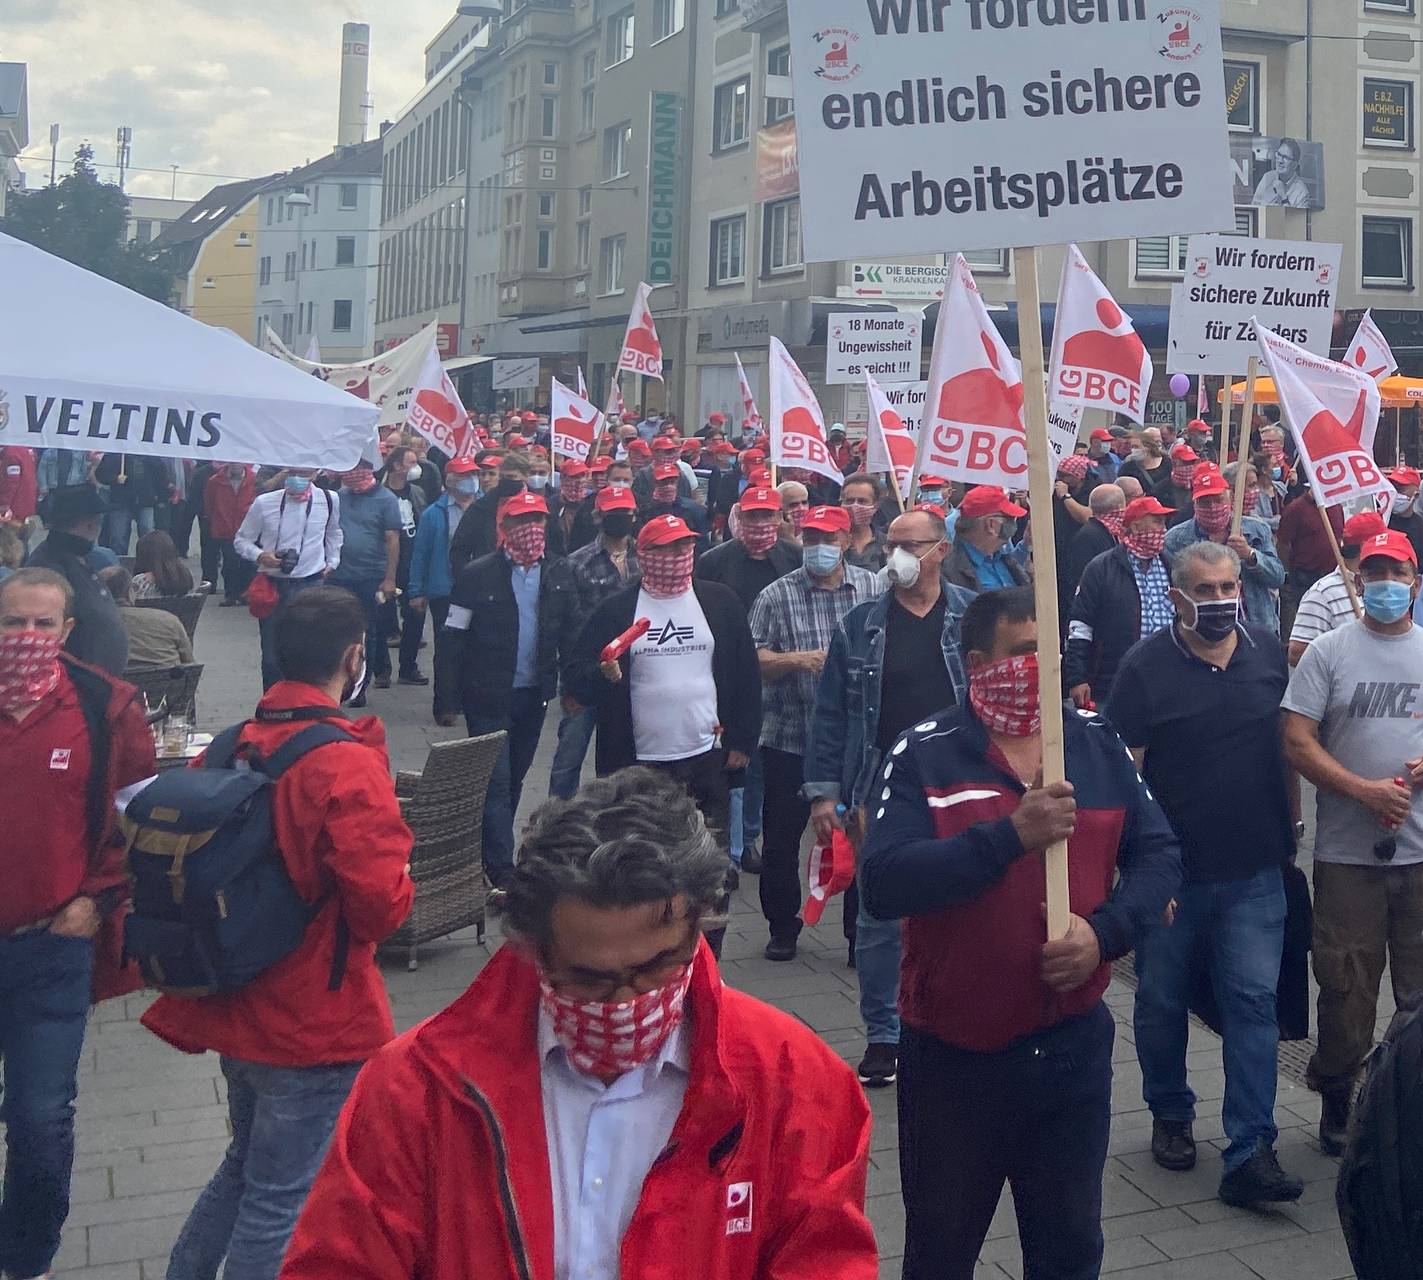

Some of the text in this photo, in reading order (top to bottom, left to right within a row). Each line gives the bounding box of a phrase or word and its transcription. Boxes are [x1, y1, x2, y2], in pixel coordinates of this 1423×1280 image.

[821, 68, 1201, 130] endlich sichere
[1226, 72, 1249, 113] NGLISCH
[1364, 104, 1405, 116] NACHHILFE
[650, 92, 678, 281] DEICHMANN
[854, 157, 1183, 220] Arbeitsplätze
[886, 266, 949, 276] DIE BERGISC
[1216, 247, 1315, 271] Wir fordern
[1190, 283, 1330, 308] sichere Zukunft
[848, 318, 904, 331] 18 Monate
[1205, 320, 1232, 341] für
[1236, 322, 1308, 345] Zaders
[838, 339, 912, 355] Ungewissheit
[848, 365, 861, 374] es
[864, 361, 896, 373] reicht
[1150, 400, 1172, 414] 100
[1150, 413, 1173, 424] TAGE
[24, 394, 222, 448] VELTINS
[1048, 411, 1077, 435] ukunft
[1347, 682, 1420, 719] NIKE
